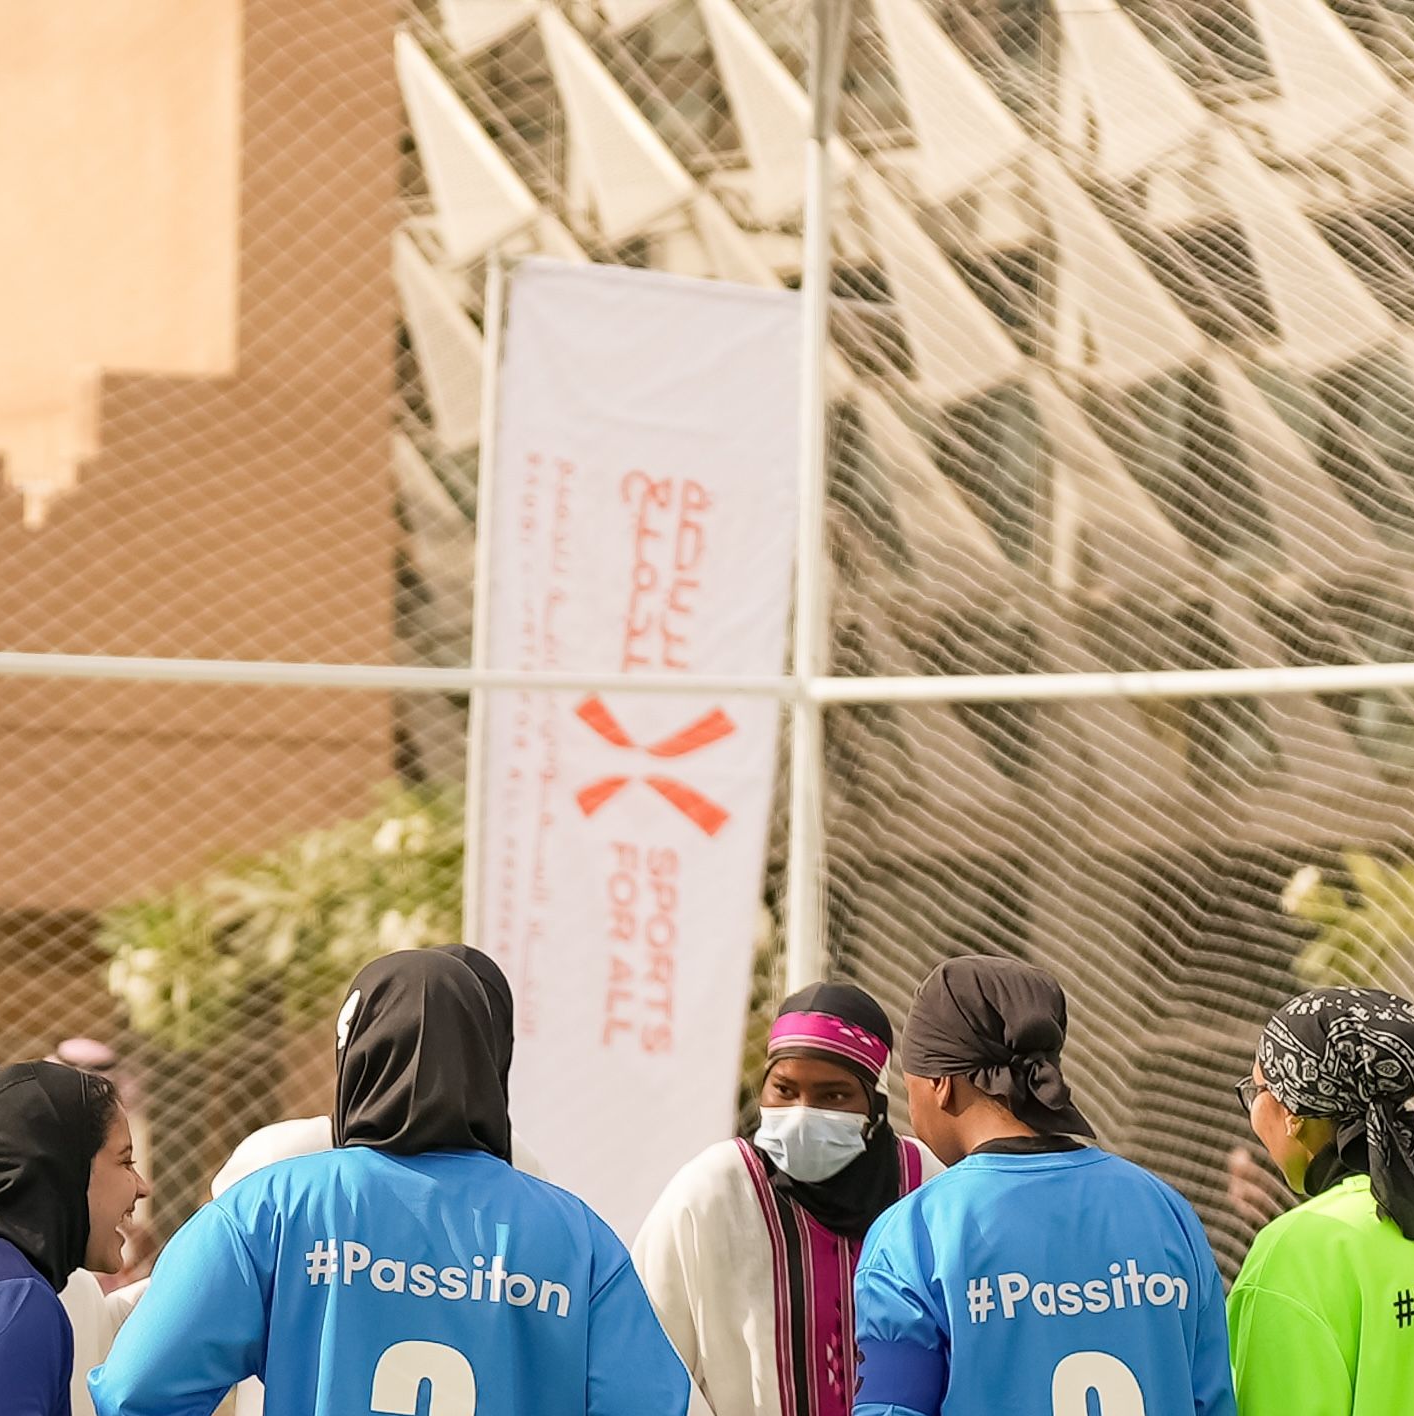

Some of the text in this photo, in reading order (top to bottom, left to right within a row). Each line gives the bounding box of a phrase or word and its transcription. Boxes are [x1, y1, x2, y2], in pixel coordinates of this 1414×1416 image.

[600, 841, 641, 1052] FOR ALL
[641, 846, 681, 1054] SPORTS
[305, 1238, 571, 1318] #Passiton
[966, 1259, 1189, 1324] #Passiton
